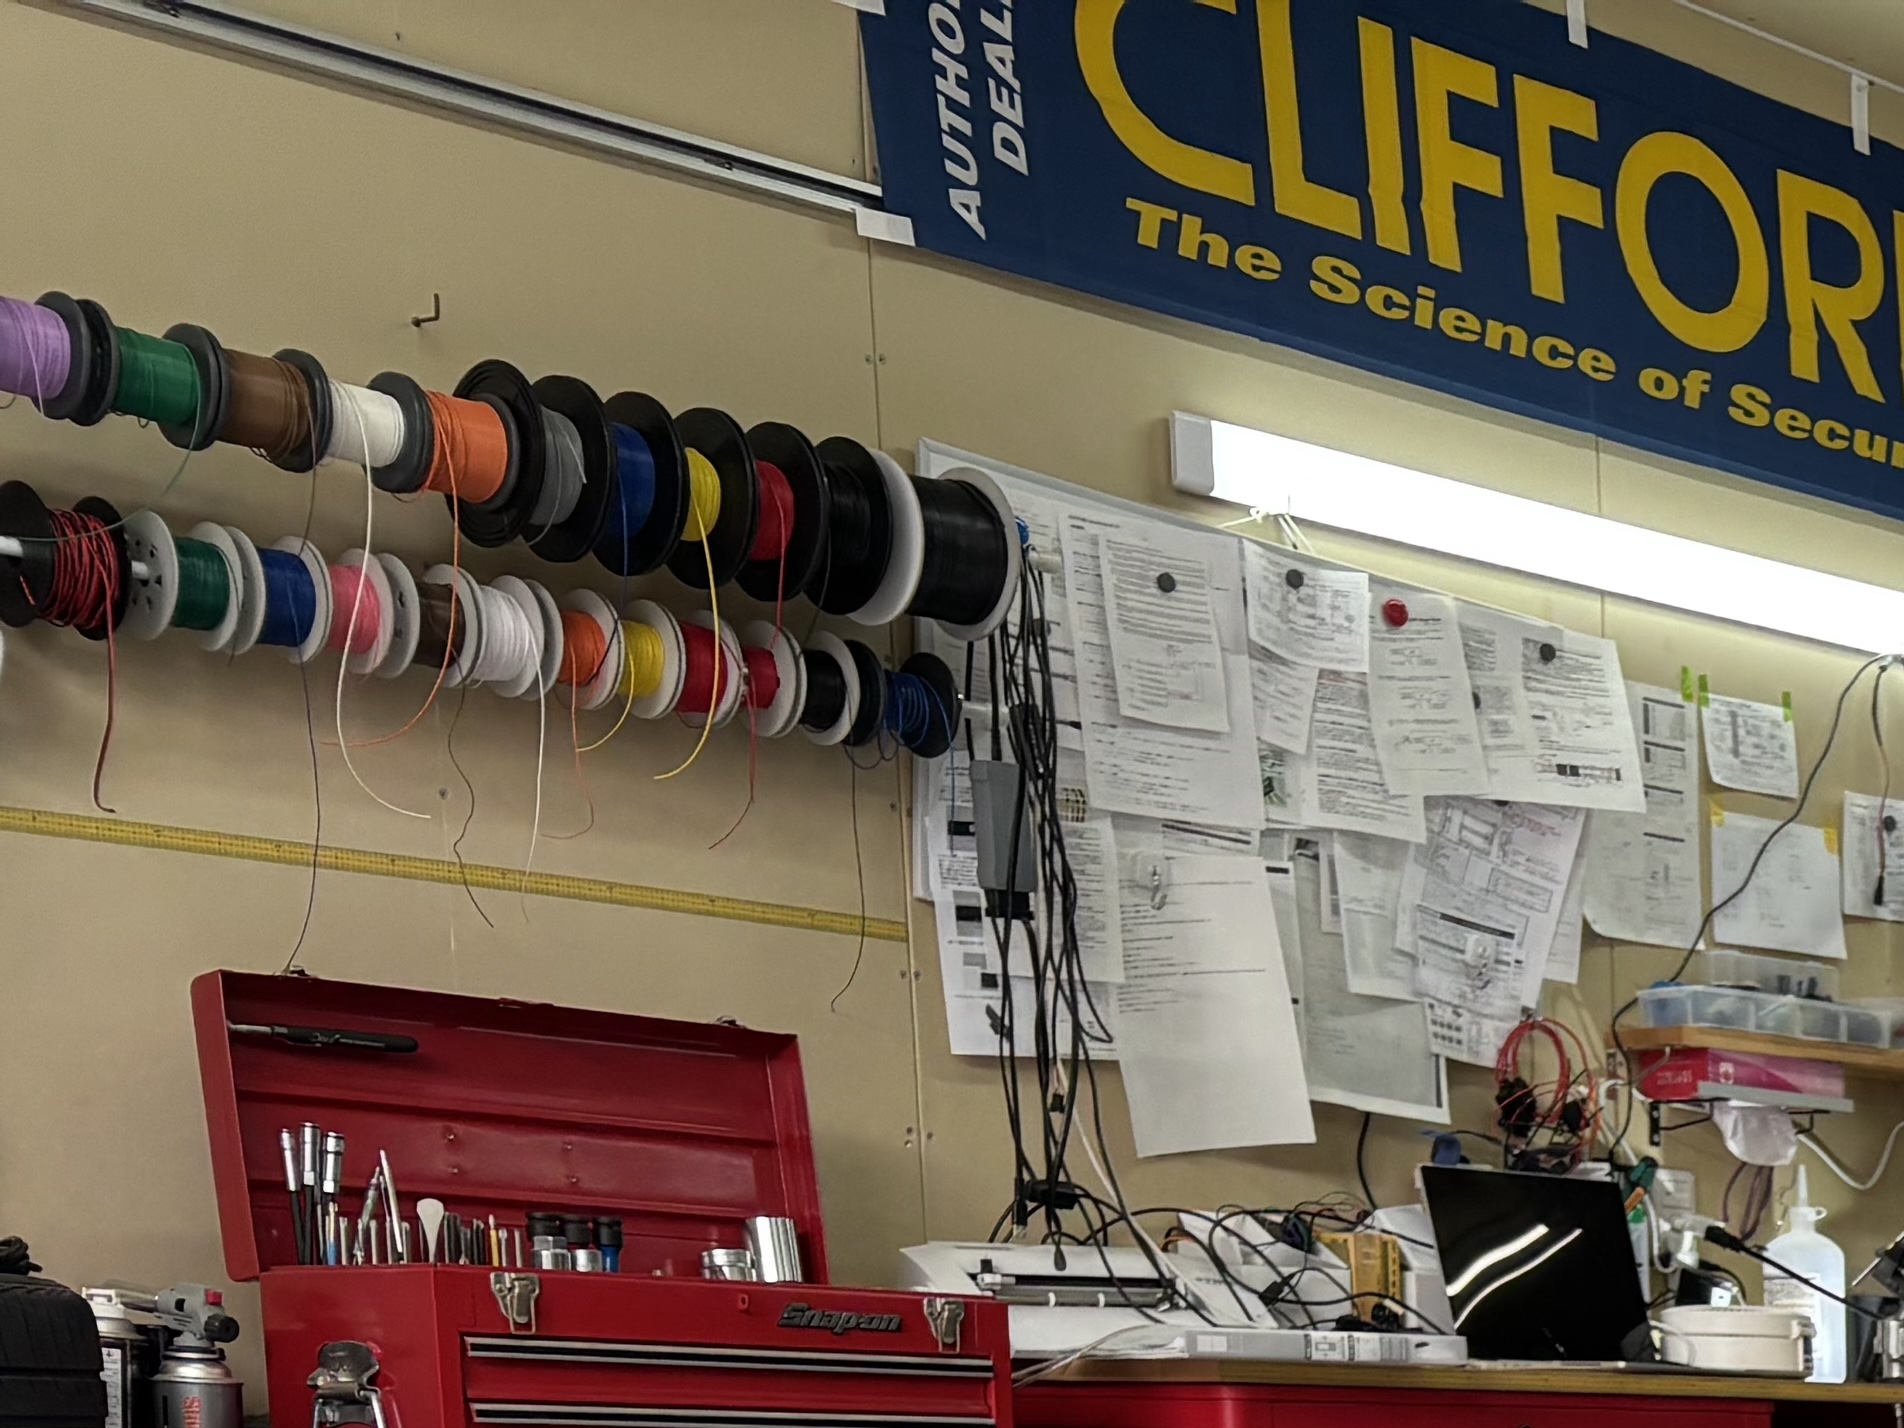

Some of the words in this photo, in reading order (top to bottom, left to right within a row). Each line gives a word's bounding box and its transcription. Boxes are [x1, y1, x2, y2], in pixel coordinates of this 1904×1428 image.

[928, 0, 986, 240] AUTHO
[980, 0, 1029, 176] DEAL
[1126, 197, 1282, 280] The
[1309, 255, 1616, 382] Science
[1638, 368, 1712, 409] of
